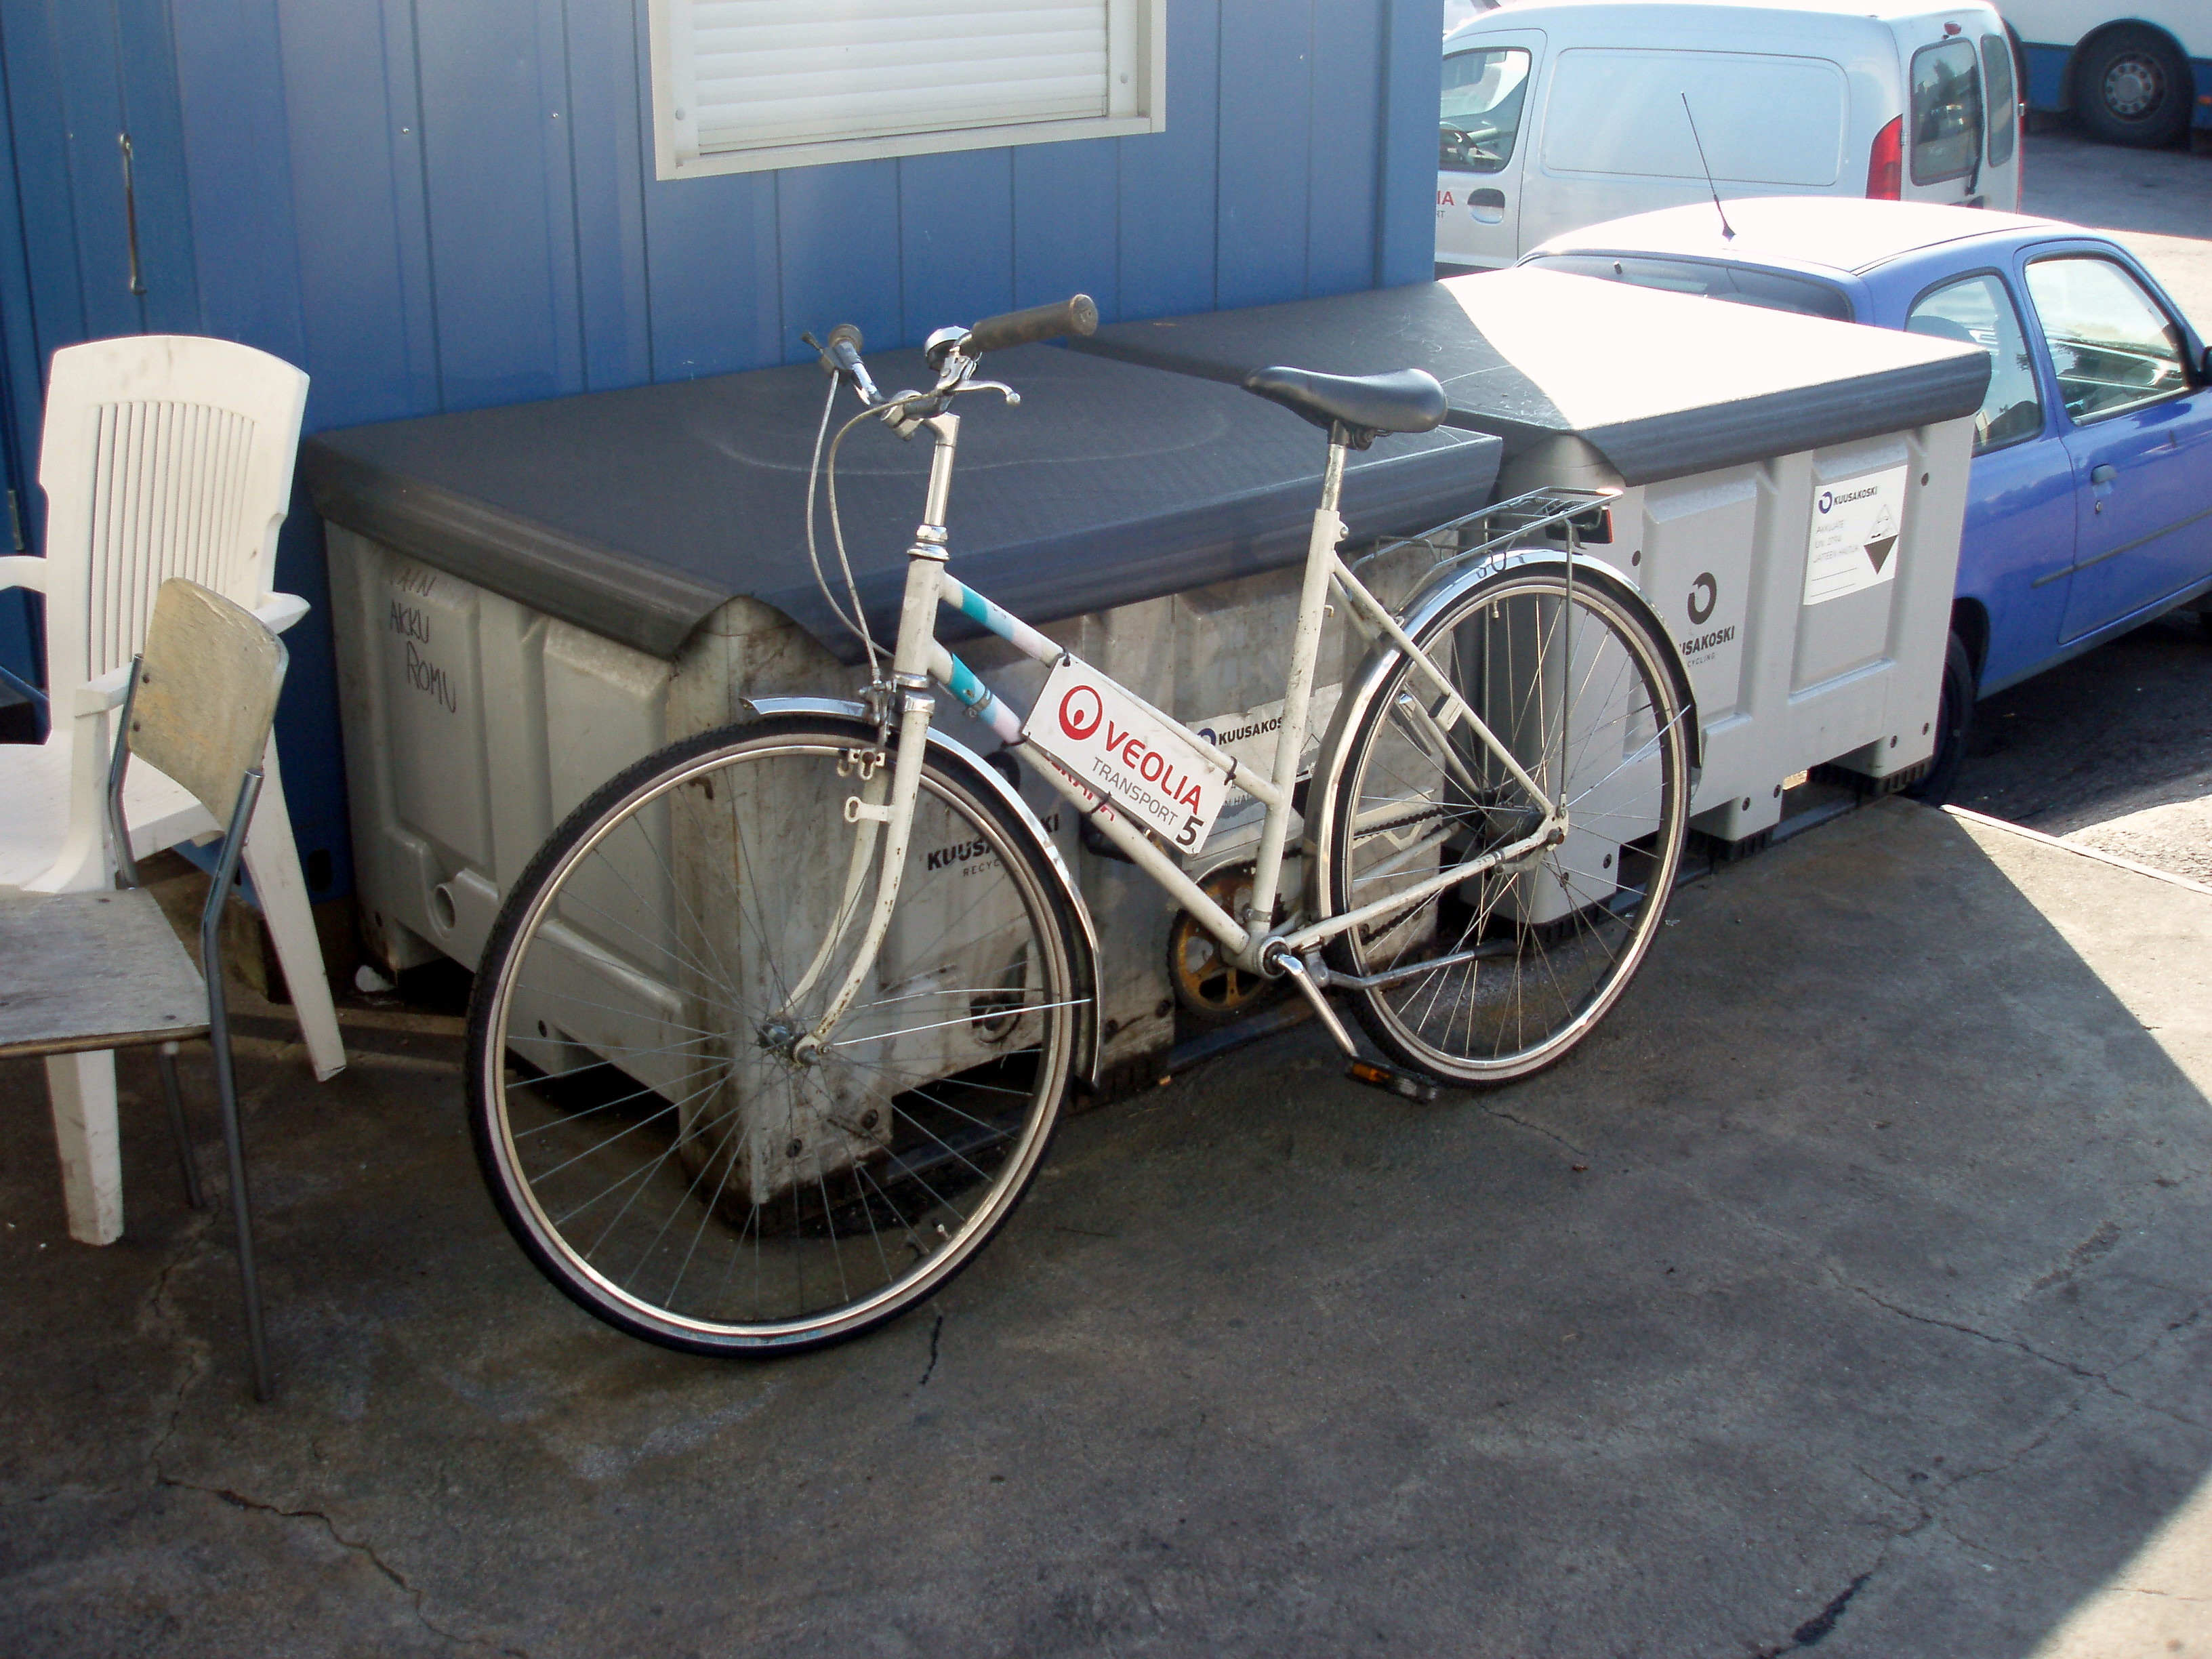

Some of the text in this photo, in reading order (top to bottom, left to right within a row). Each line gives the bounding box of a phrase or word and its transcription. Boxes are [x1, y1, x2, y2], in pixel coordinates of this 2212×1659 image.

[1833, 486, 1878, 506] KUUSAKOSKI
[390, 598, 429, 644] AKKU
[407, 640, 457, 713] ROMU
[1218, 716, 1283, 745] KUUSAKOS
[1092, 756, 1179, 825] TRANSPORT
[1105, 720, 1202, 815] VEOLIA
[1175, 815, 1205, 846] 5
